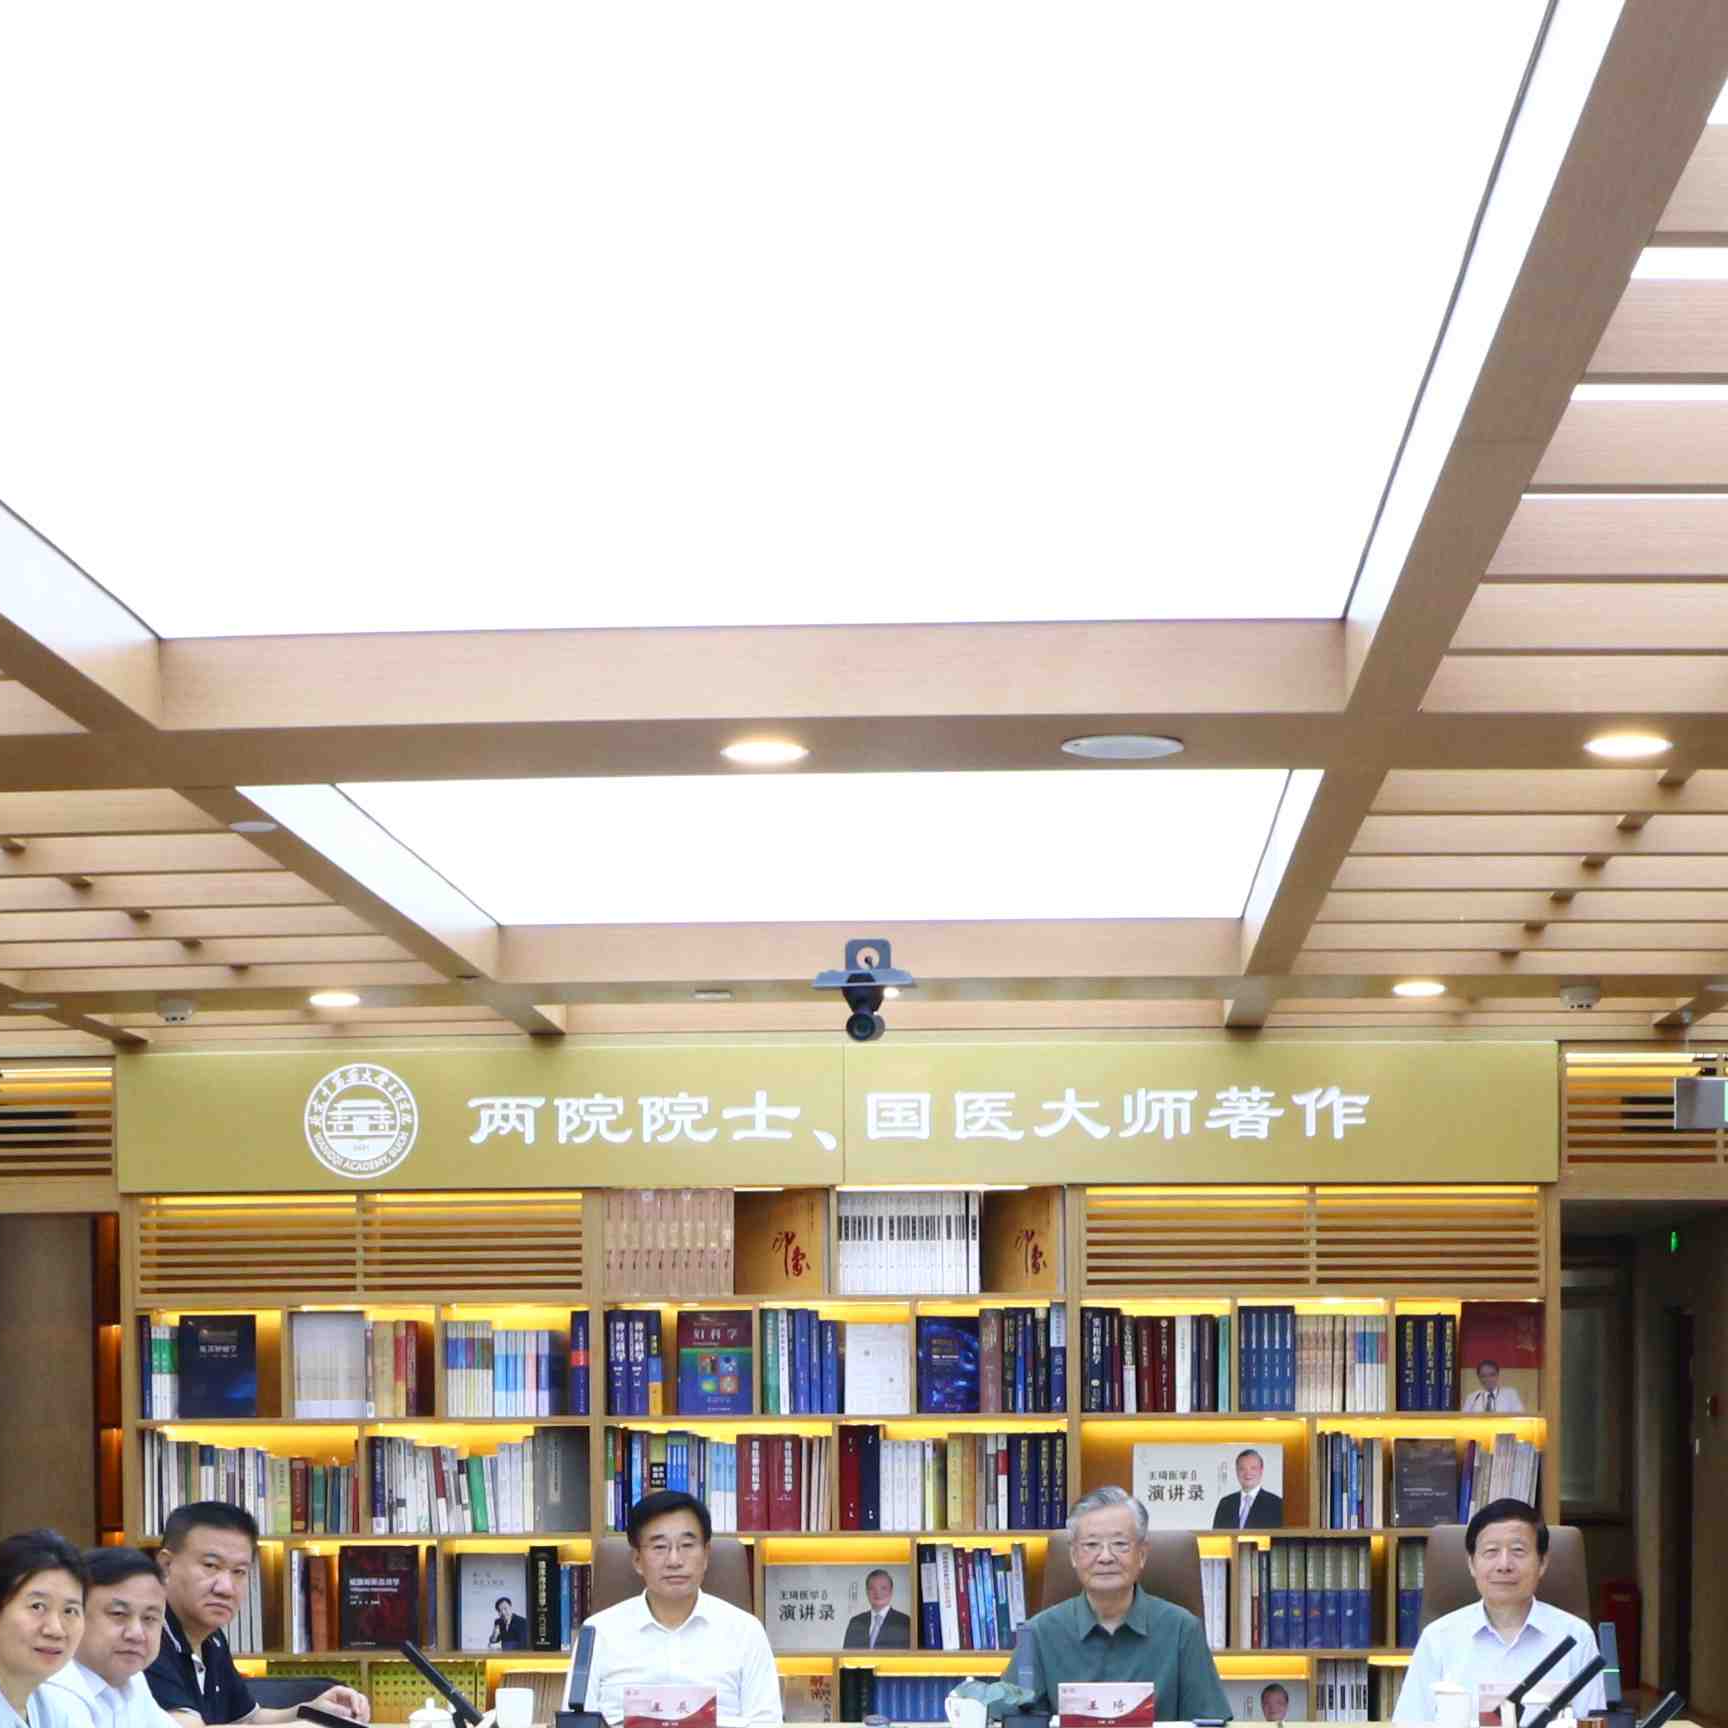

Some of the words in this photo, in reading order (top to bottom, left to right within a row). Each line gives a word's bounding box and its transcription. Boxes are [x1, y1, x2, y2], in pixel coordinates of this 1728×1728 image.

[465, 1086, 1371, 1152] 两院院士、国医大师著作
[1147, 1485, 1205, 1502] 演讲录
[778, 1603, 836, 1621] 演讲录
